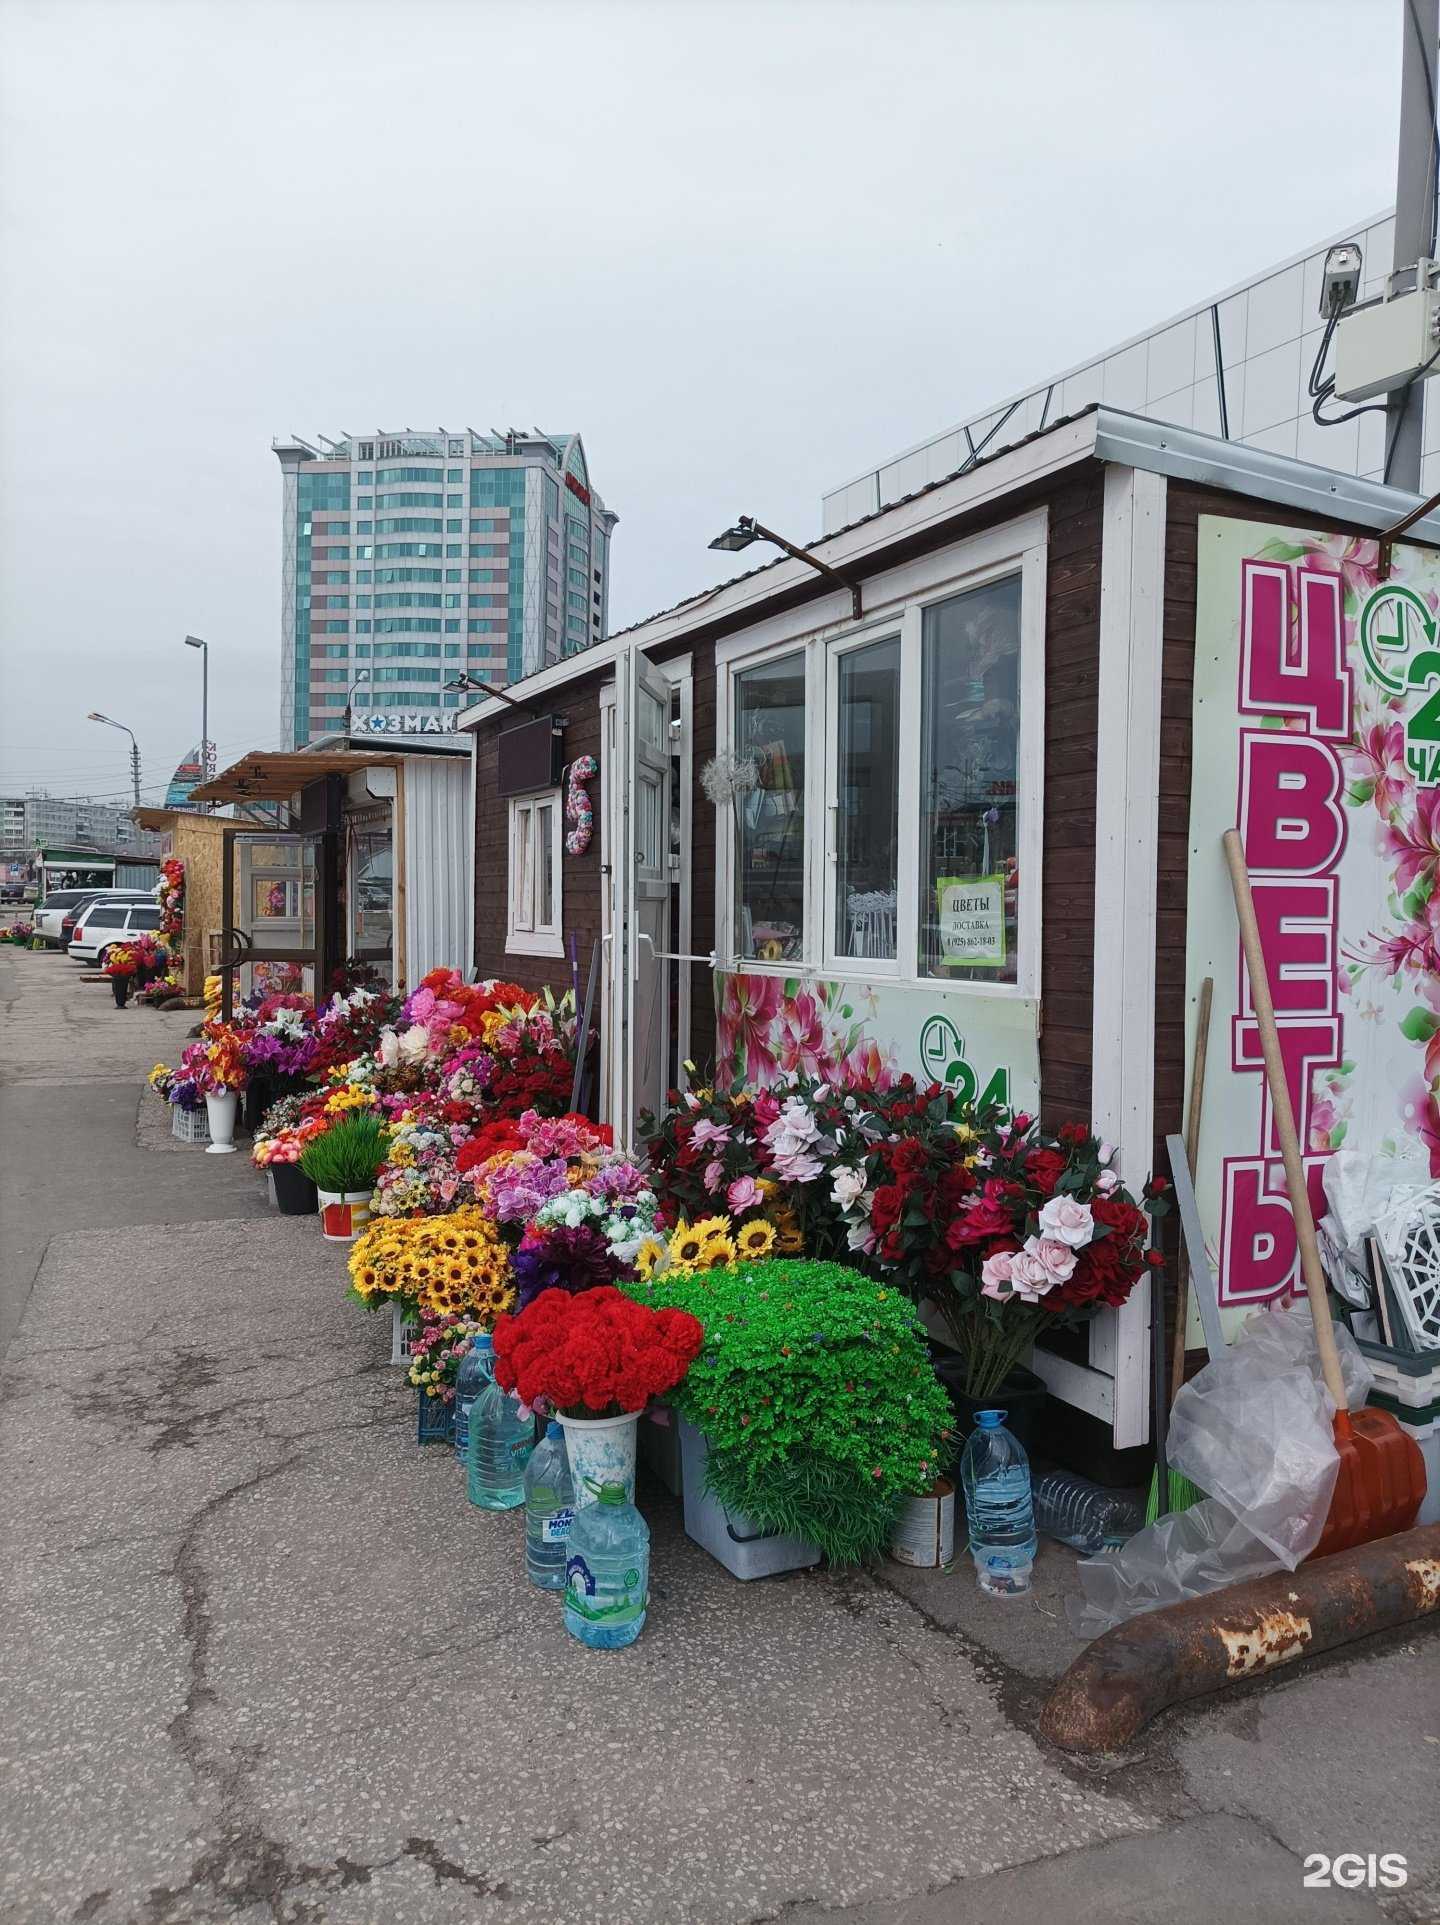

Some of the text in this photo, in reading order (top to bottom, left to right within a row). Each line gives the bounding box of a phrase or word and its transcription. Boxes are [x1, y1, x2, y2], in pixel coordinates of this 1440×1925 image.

[952, 897, 990, 912] ЦВЕТЫ
[953, 921, 990, 930] ДОСТАВКА
[1218, 558, 1353, 1306] ЦВЕТЫ
[945, 1060, 1011, 1127] 24
